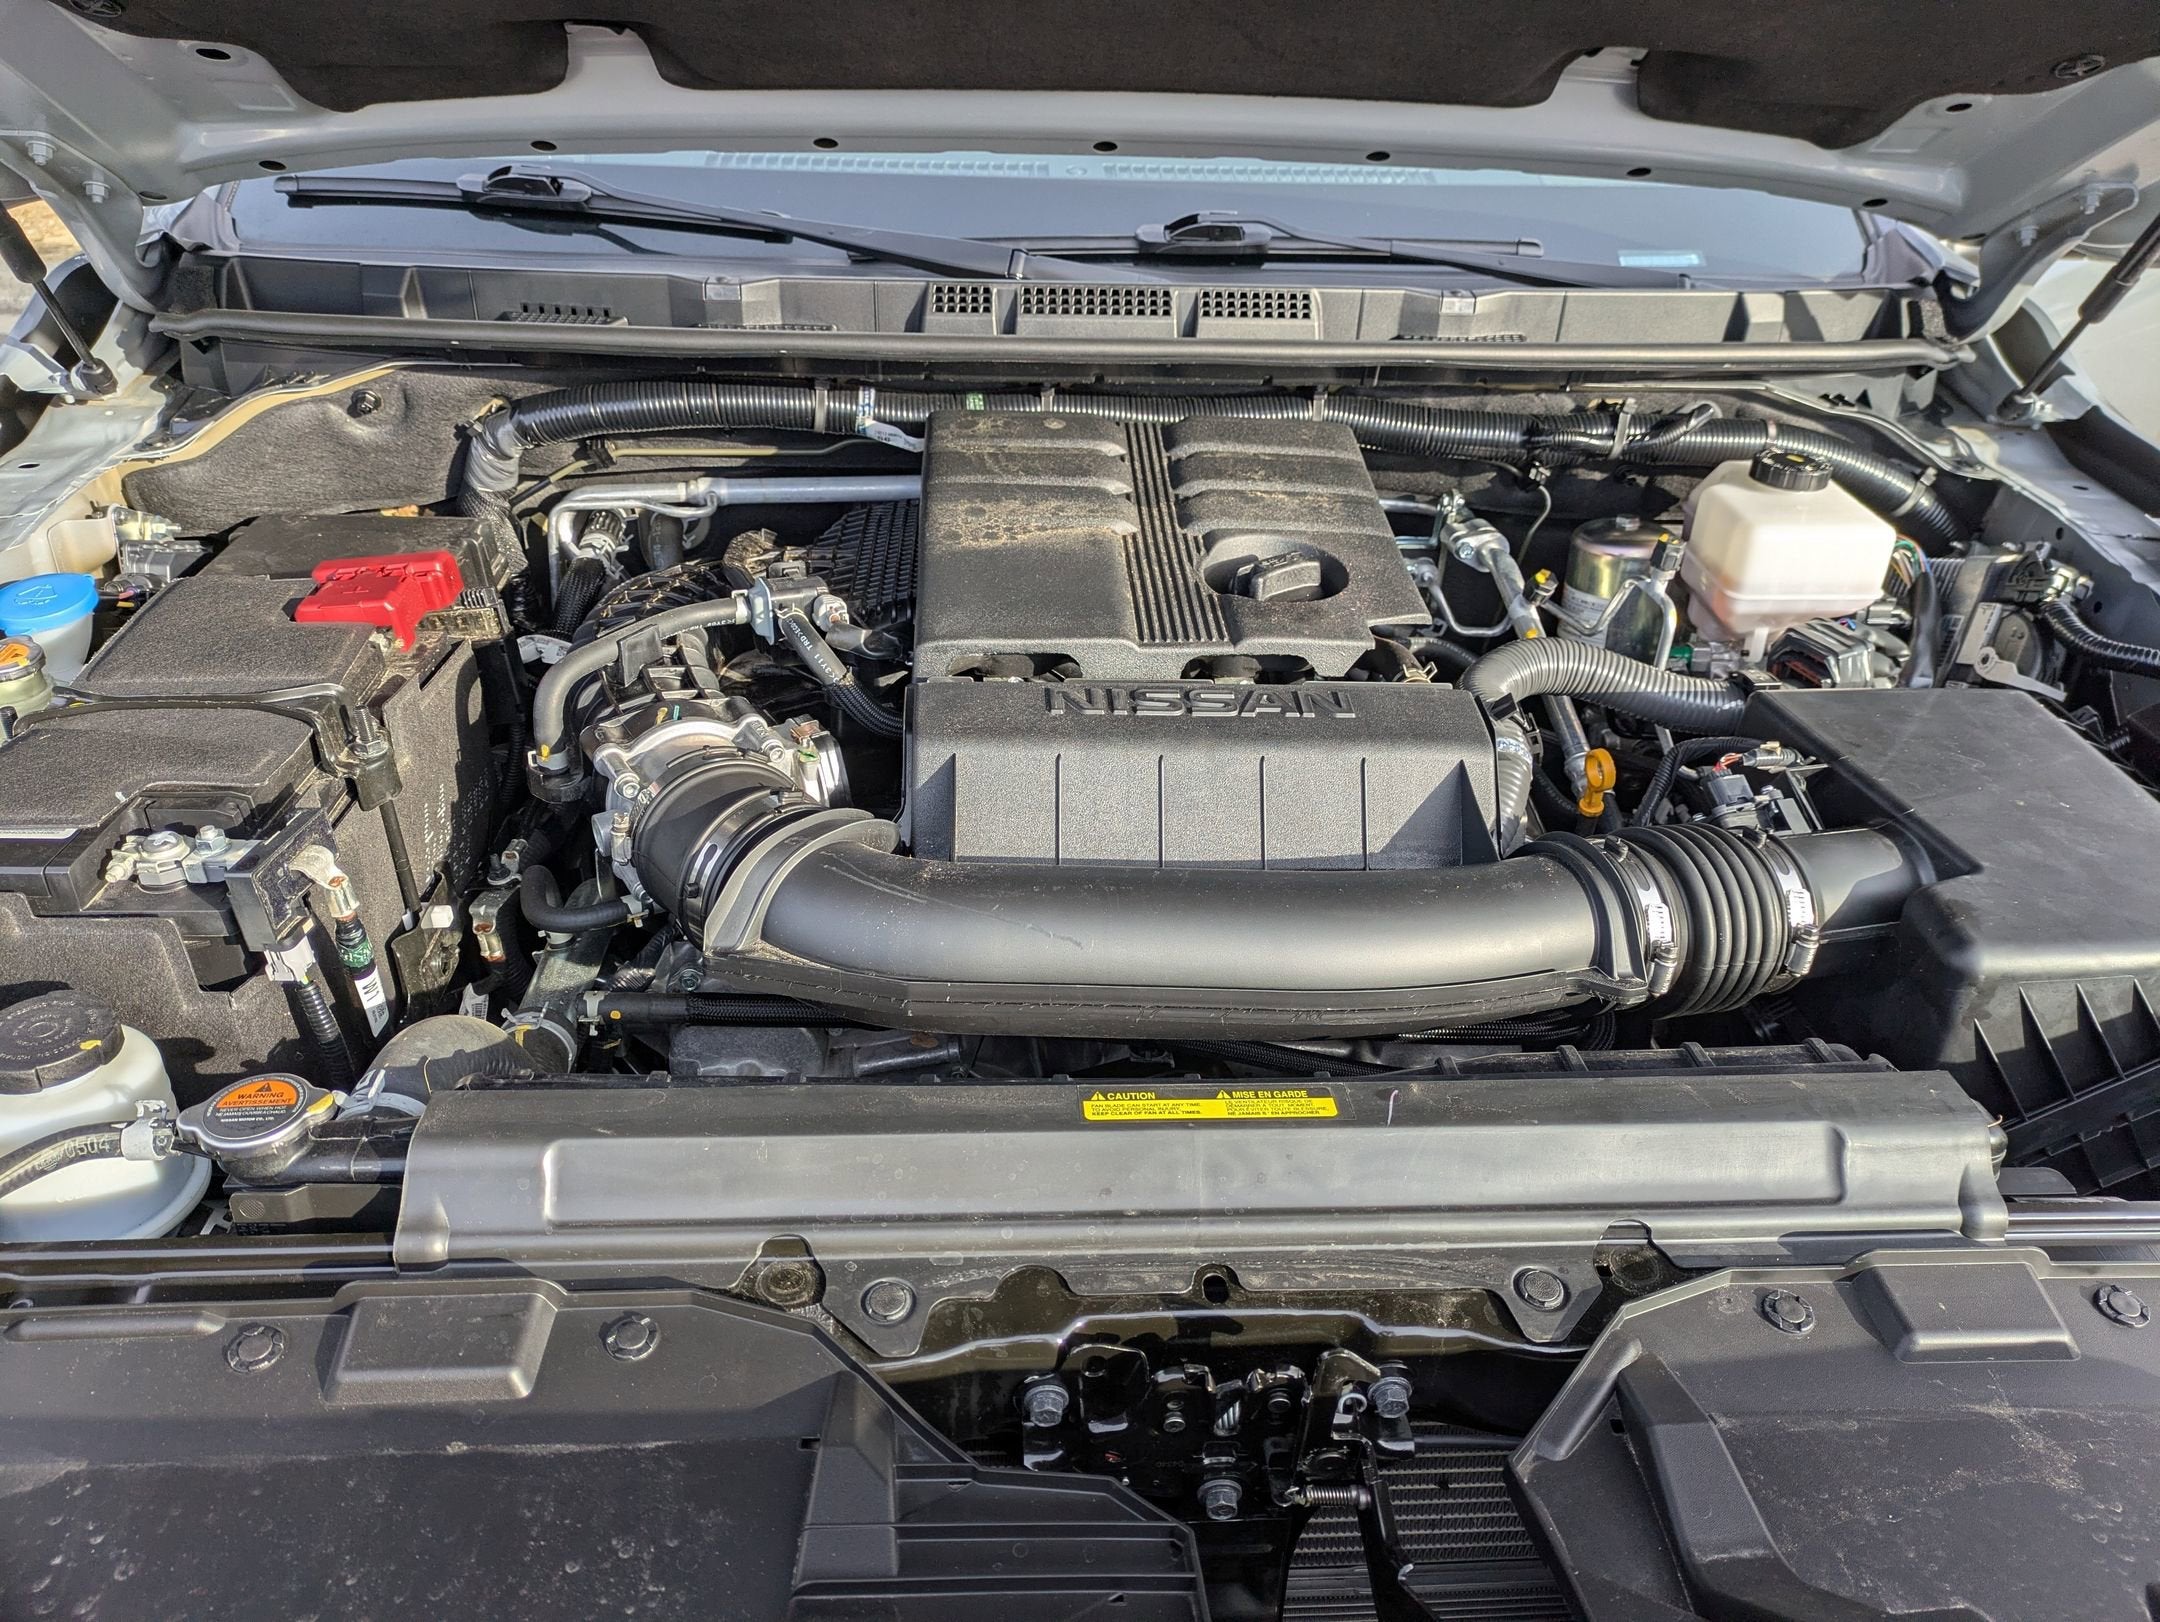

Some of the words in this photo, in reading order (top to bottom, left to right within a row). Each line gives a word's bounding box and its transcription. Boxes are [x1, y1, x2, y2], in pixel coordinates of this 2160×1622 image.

[1044, 686, 1356, 719] NISSAN
[1107, 1092, 1156, 1101] CAUTION
[1232, 1091, 1256, 1099] MISE
[1273, 1090, 1308, 1098] GARDE
[222, 1098, 292, 1106] AVERTISSEMENT
[64, 1136, 110, 1159] 0504
